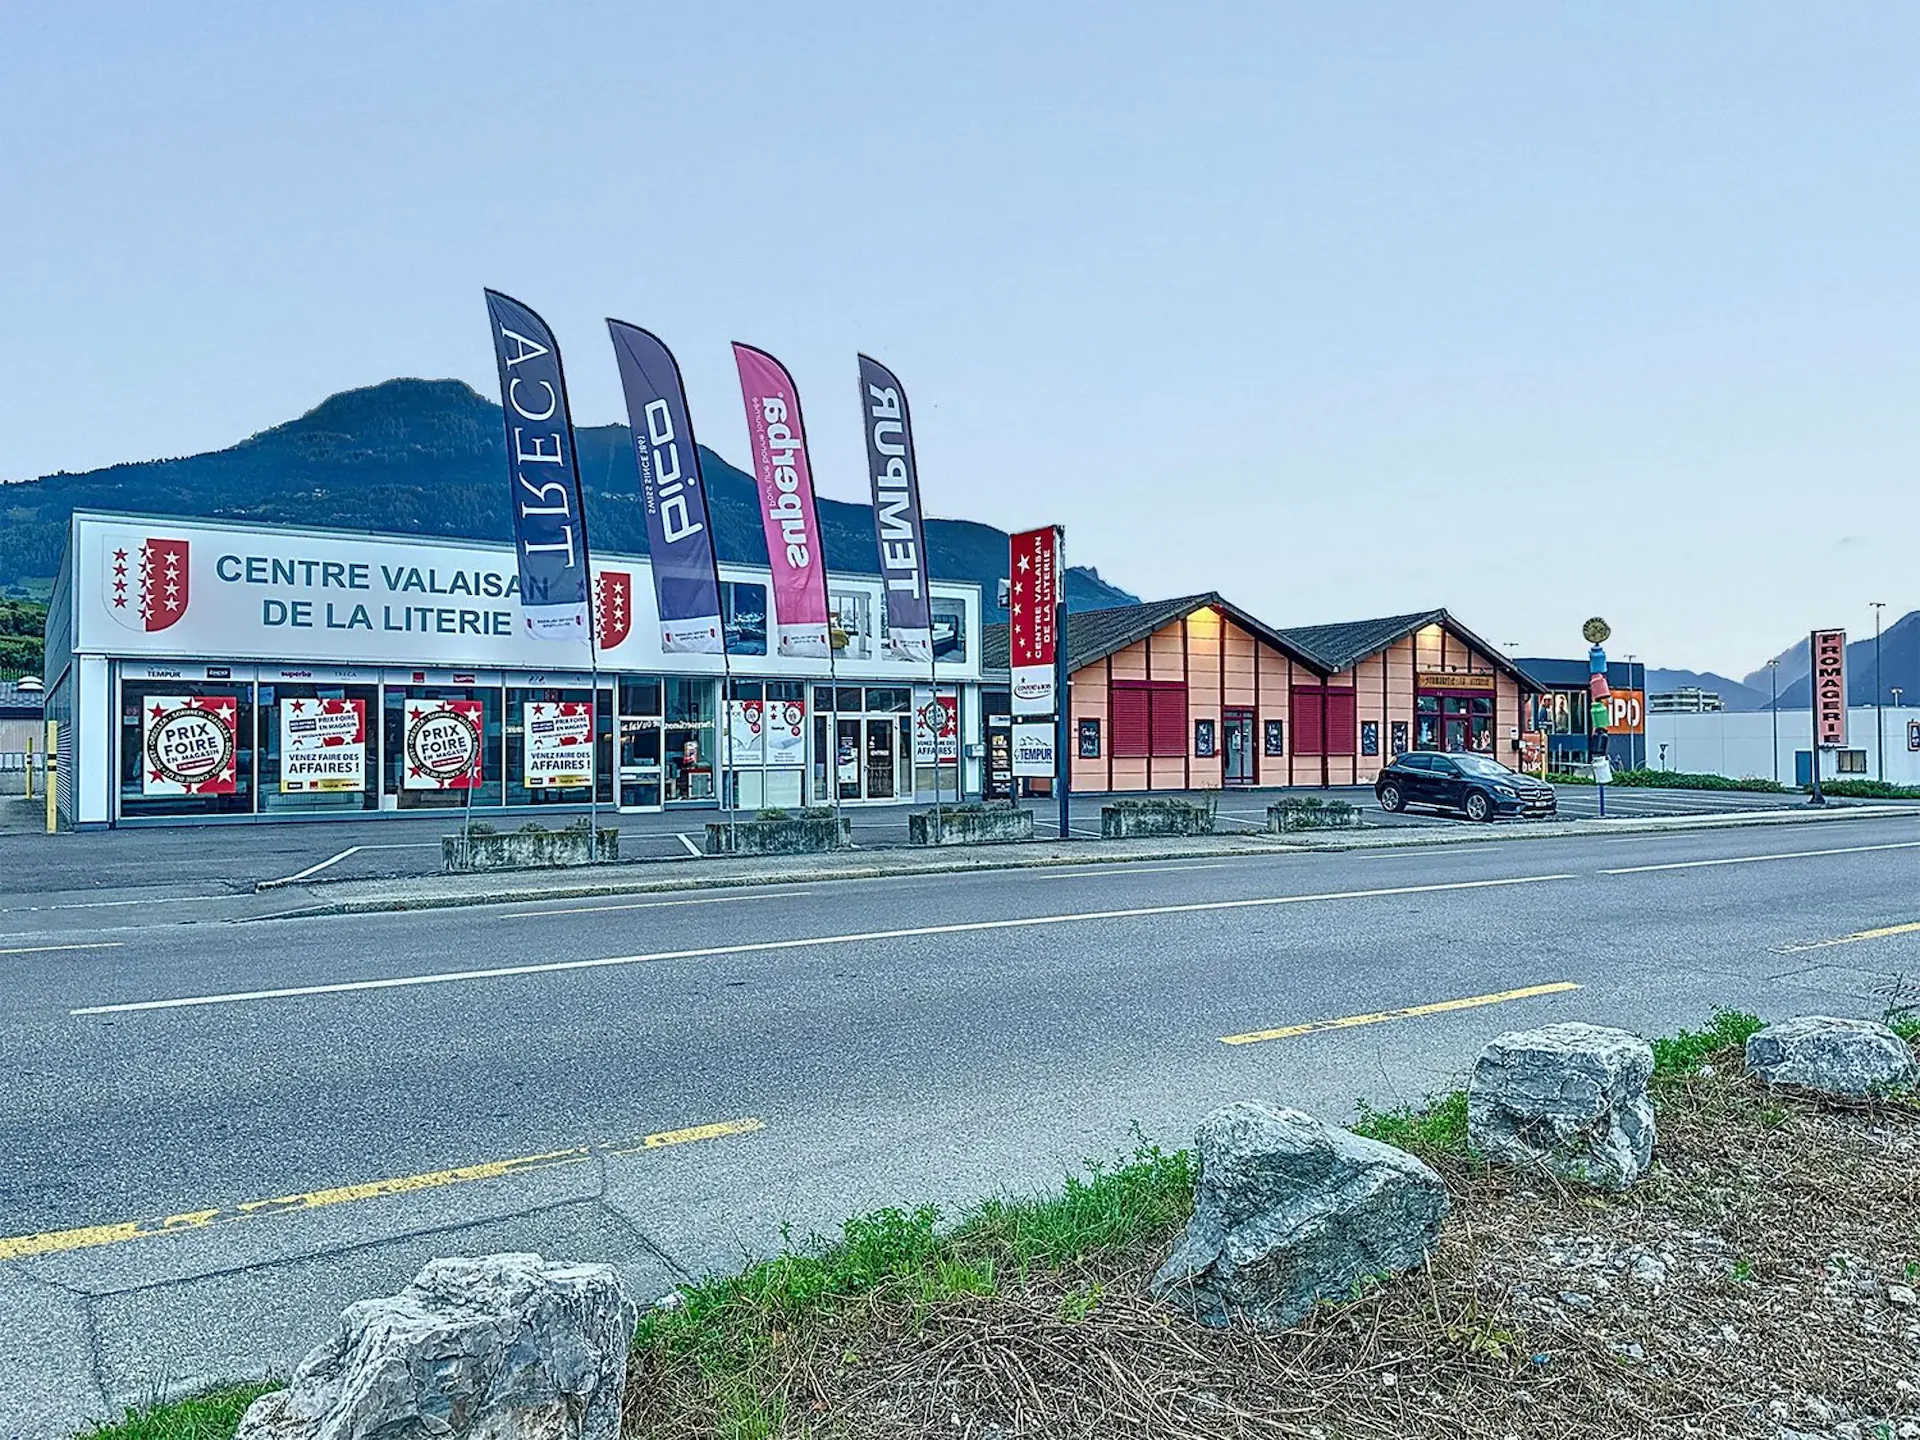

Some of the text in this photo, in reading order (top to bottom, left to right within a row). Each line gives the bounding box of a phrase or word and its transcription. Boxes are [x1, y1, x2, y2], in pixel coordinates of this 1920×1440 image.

[216, 555, 549, 600] CENTRE VALAISAN
[1034, 536, 1042, 659] CENTRE VALAISAN
[1043, 549, 1051, 643] DE LA LITERIE
[263, 599, 313, 627] DE
[326, 603, 373, 630] LA
[384, 606, 513, 636] LITERIE
[281, 670, 312, 679] superba
[1818, 634, 1842, 744] FROMAGERIE
[165, 722, 210, 742] PRIX
[422, 724, 460, 741] PRIX
[163, 736, 218, 757] FOIRE
[421, 736, 467, 754] FOIRE
[436, 748, 468, 758] MAGASIN
[181, 749, 219, 760] MAGASIN
[289, 753, 317, 761] VENEZ
[1019, 748, 1053, 760] TEMPUR
[288, 762, 353, 774] AFFAIRES
[530, 760, 585, 771] AFFAIRES
